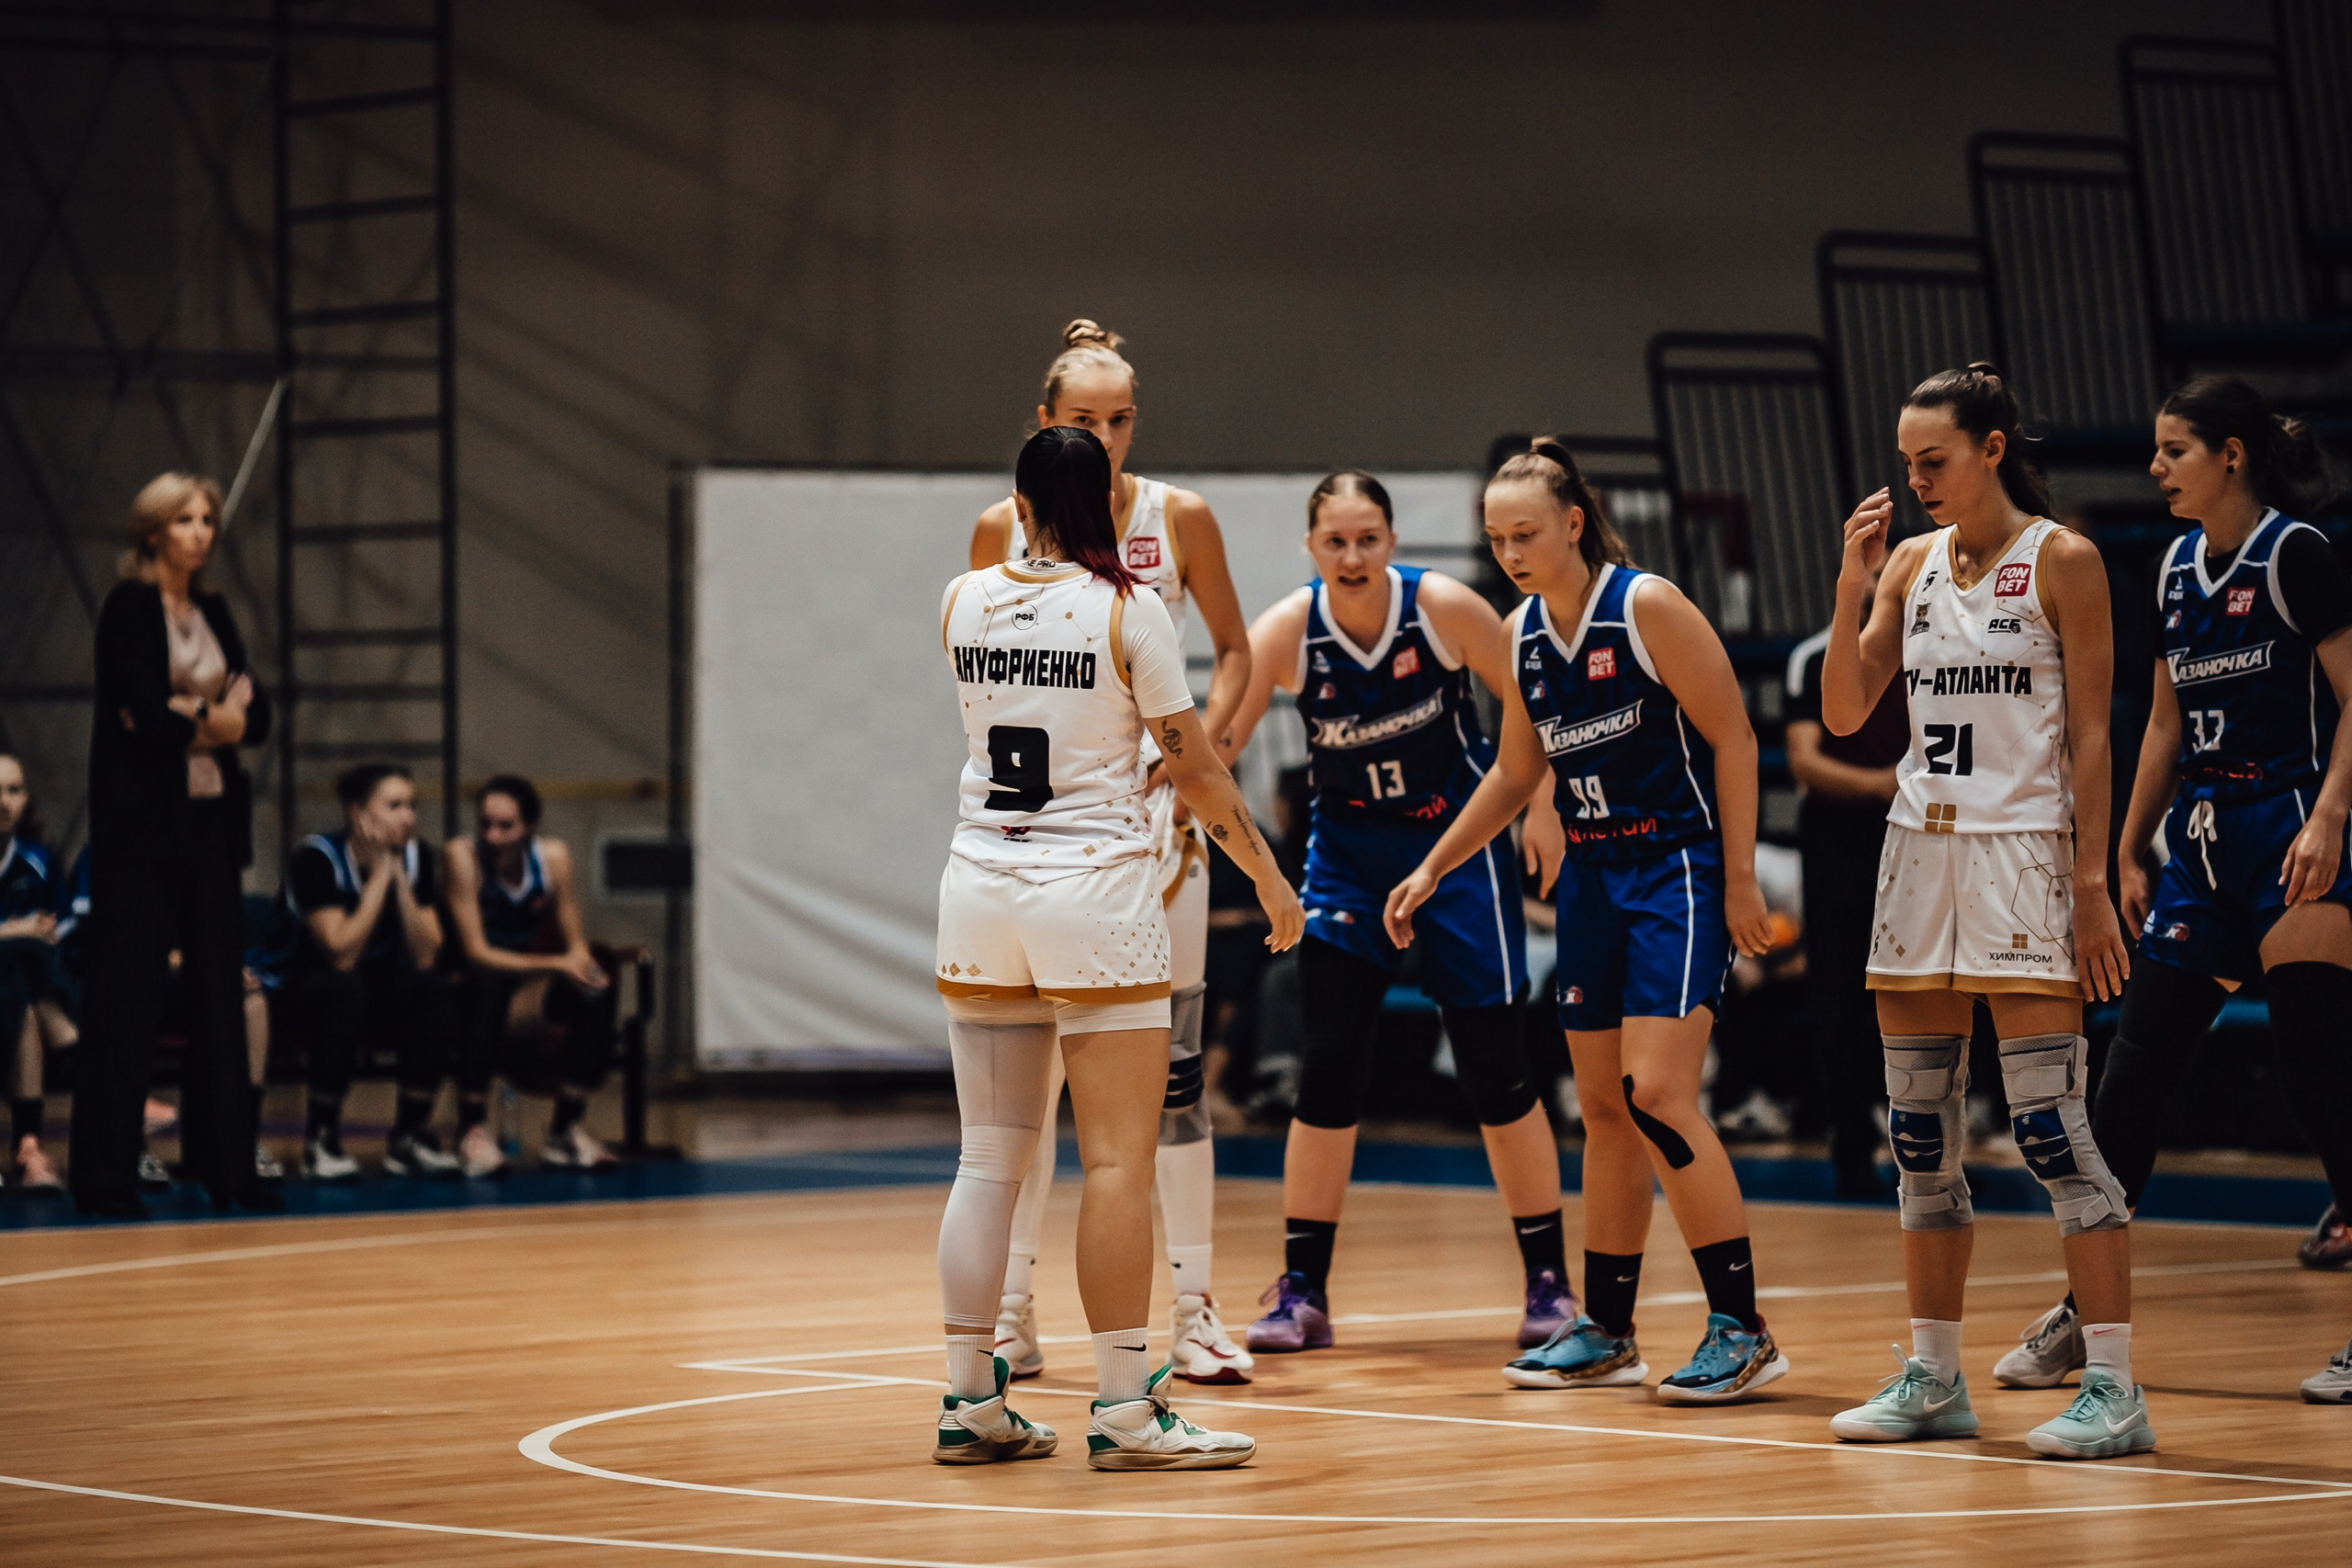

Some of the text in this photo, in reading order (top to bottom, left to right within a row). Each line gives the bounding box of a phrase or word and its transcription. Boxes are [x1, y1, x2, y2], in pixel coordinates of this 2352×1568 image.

[1128, 552, 1157, 566] BET
[1999, 567, 2030, 580] FON
[1996, 579, 2027, 593] BET
[2229, 590, 2256, 602] FON
[2227, 601, 2253, 613] BET
[1015, 613, 1035, 621] РФБ
[1589, 649, 1612, 664] FON
[954, 646, 1096, 690] АНУФРИЕНКО
[1589, 661, 1613, 678] BET
[1924, 723, 1973, 776] 21
[984, 725, 1055, 813] 9
[1366, 760, 1407, 800] 13
[1988, 952, 2052, 964] ХИМПРОМ
